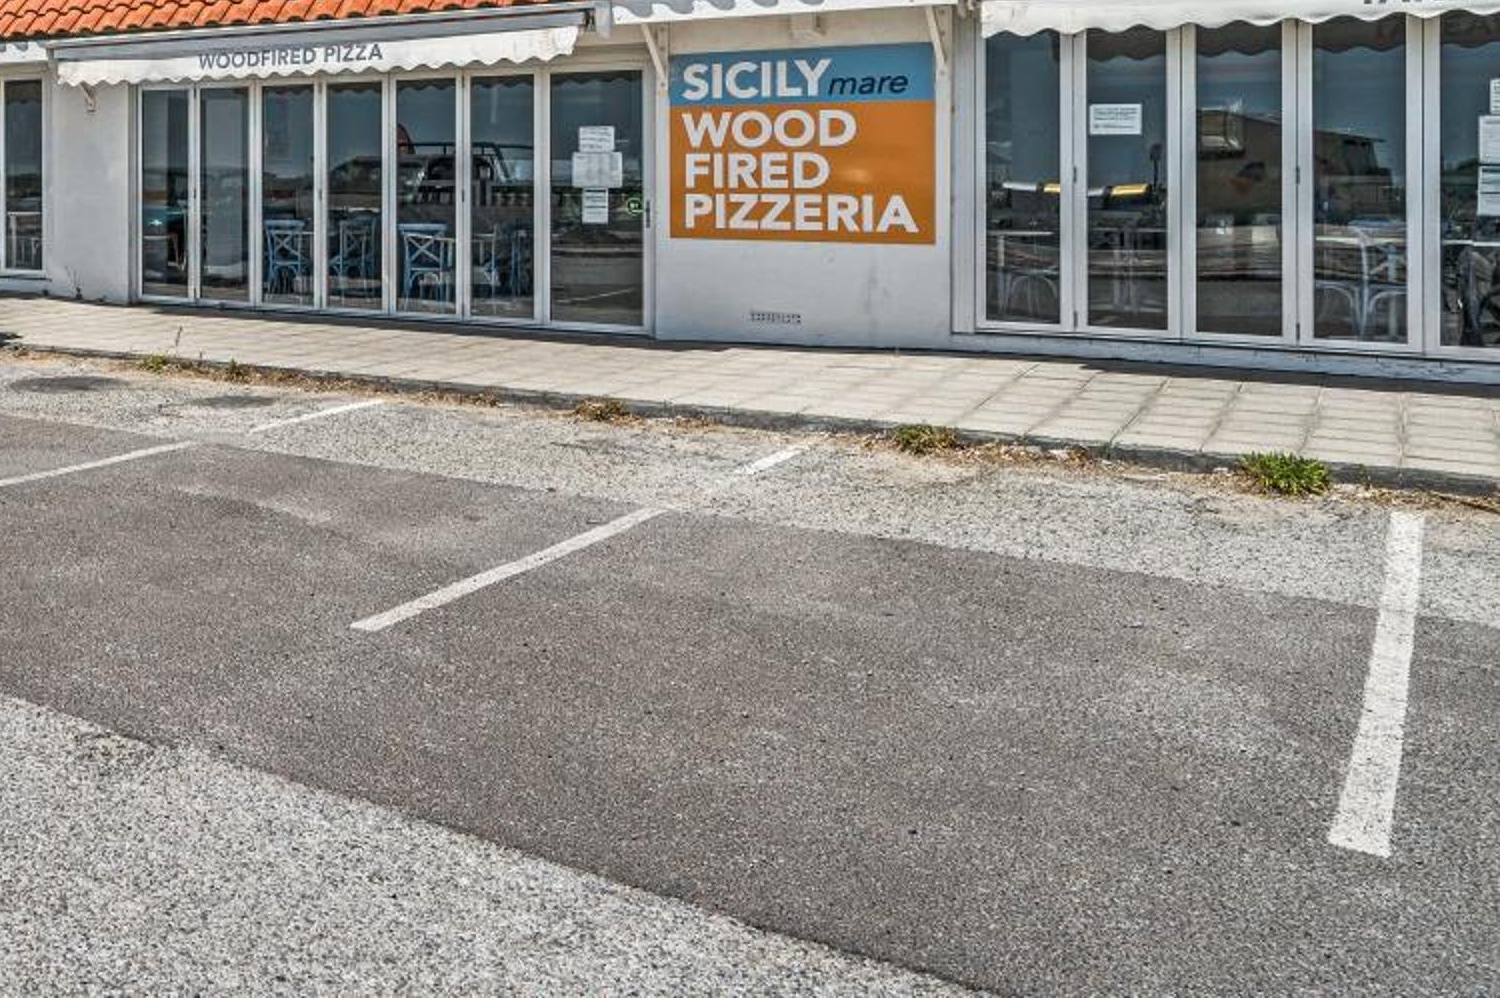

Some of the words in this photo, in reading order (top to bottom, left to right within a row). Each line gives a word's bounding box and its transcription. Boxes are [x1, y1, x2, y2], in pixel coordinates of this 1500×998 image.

[199, 48, 316, 70] WOODFIRED
[323, 44, 383, 64] PIZZA
[681, 58, 832, 101] SICILY
[827, 74, 909, 96] mare
[682, 109, 857, 148] WOOD
[684, 152, 830, 189] FIRED
[684, 193, 919, 233] PIZZERIA
